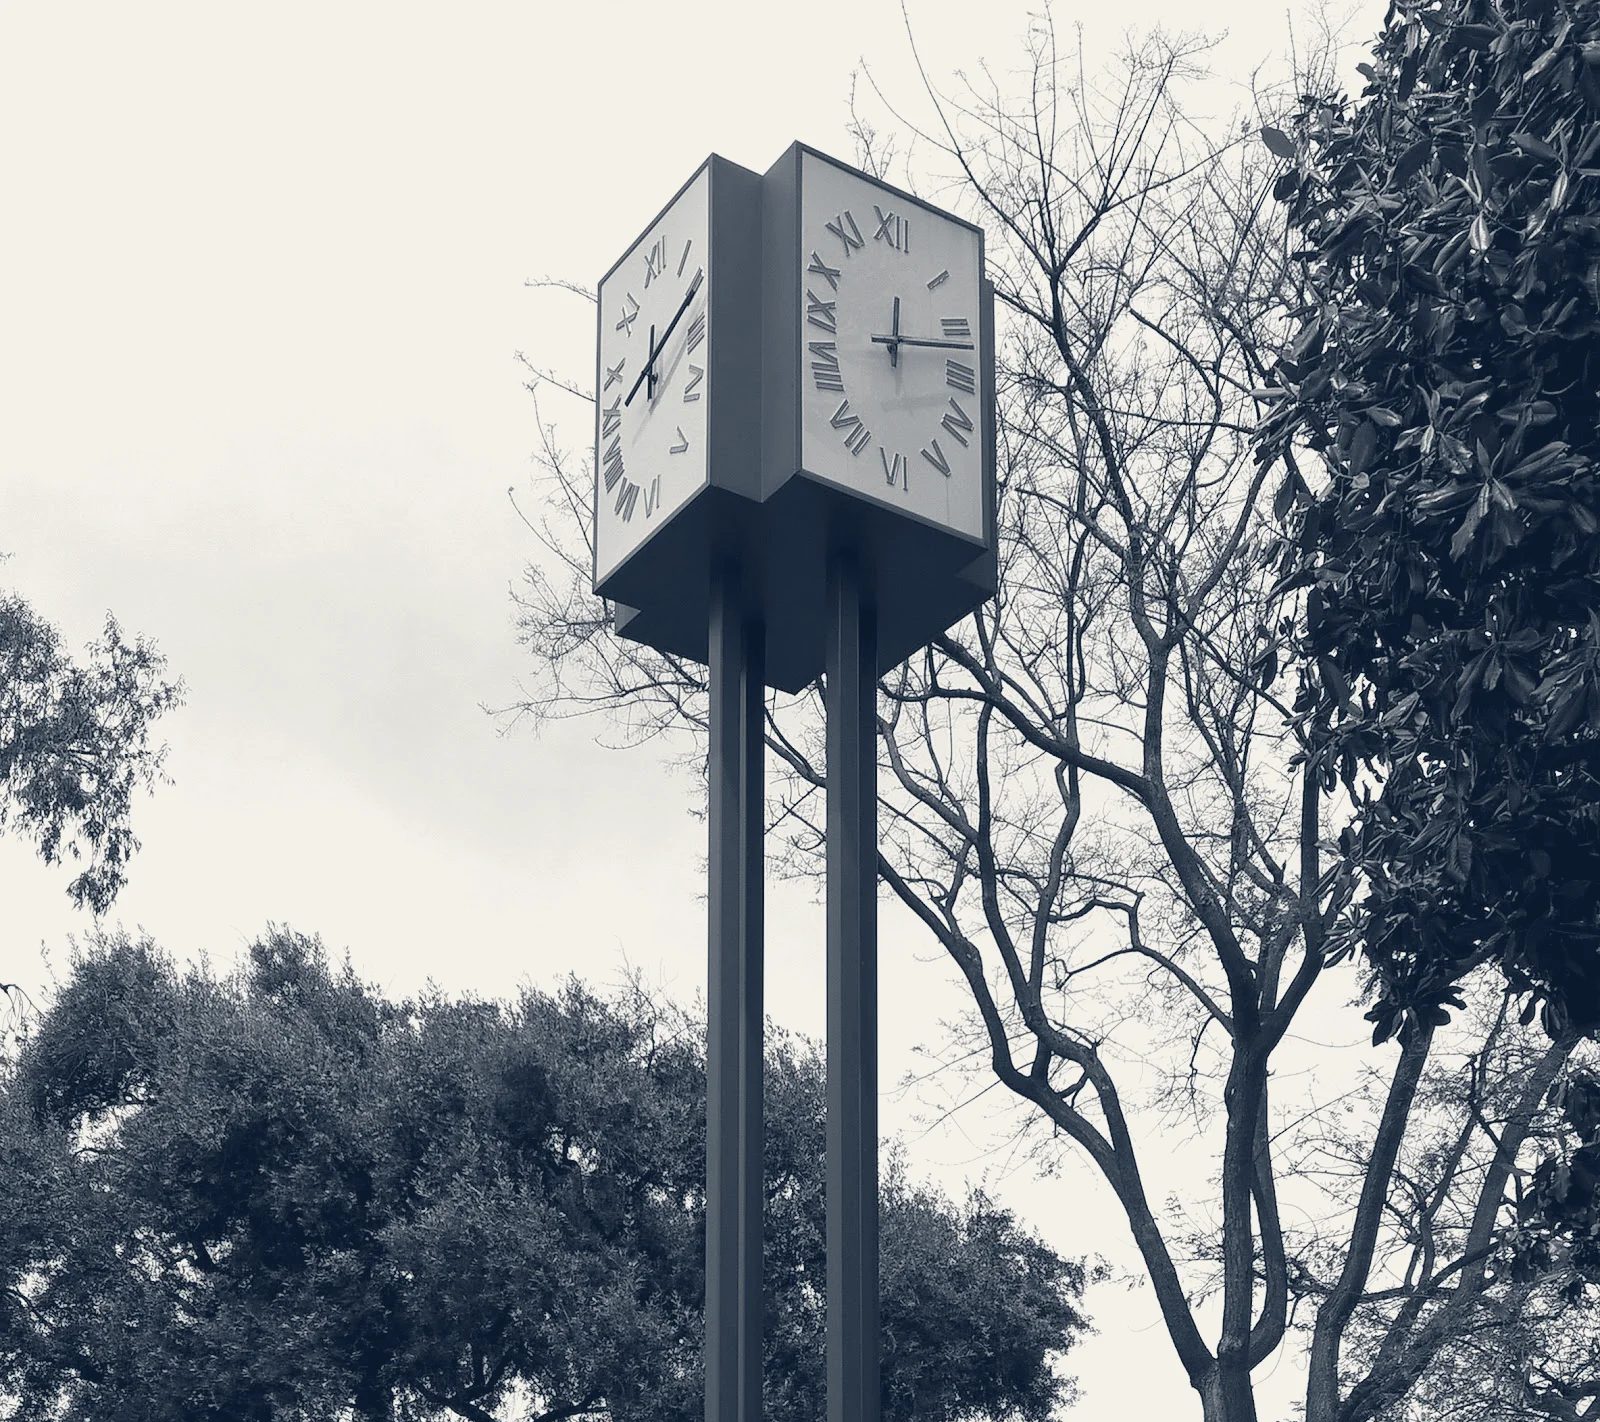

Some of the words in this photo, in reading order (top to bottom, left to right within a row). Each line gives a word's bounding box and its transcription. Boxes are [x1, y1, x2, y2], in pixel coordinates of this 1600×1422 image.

[825, 209, 865, 257] XI
[873, 204, 909, 254] XII
[644, 235, 666, 289] XII
[806, 249, 842, 292] X
[616, 292, 640, 338] XI
[687, 311, 706, 355] III
[806, 287, 837, 335] IX
[940, 318, 971, 336] II
[603, 357, 625, 392] X
[683, 363, 704, 403] IV
[808, 341, 845, 392] VIII
[946, 359, 975, 395] III
[602, 393, 621, 440] IX
[669, 426, 689, 454] V
[829, 398, 872, 457] VII
[940, 397, 974, 448] IV
[602, 433, 625, 495] VIII
[879, 445, 908, 492] VI
[920, 439, 951, 478] V
[614, 476, 640, 523] VII
[643, 473, 661, 519] VI
